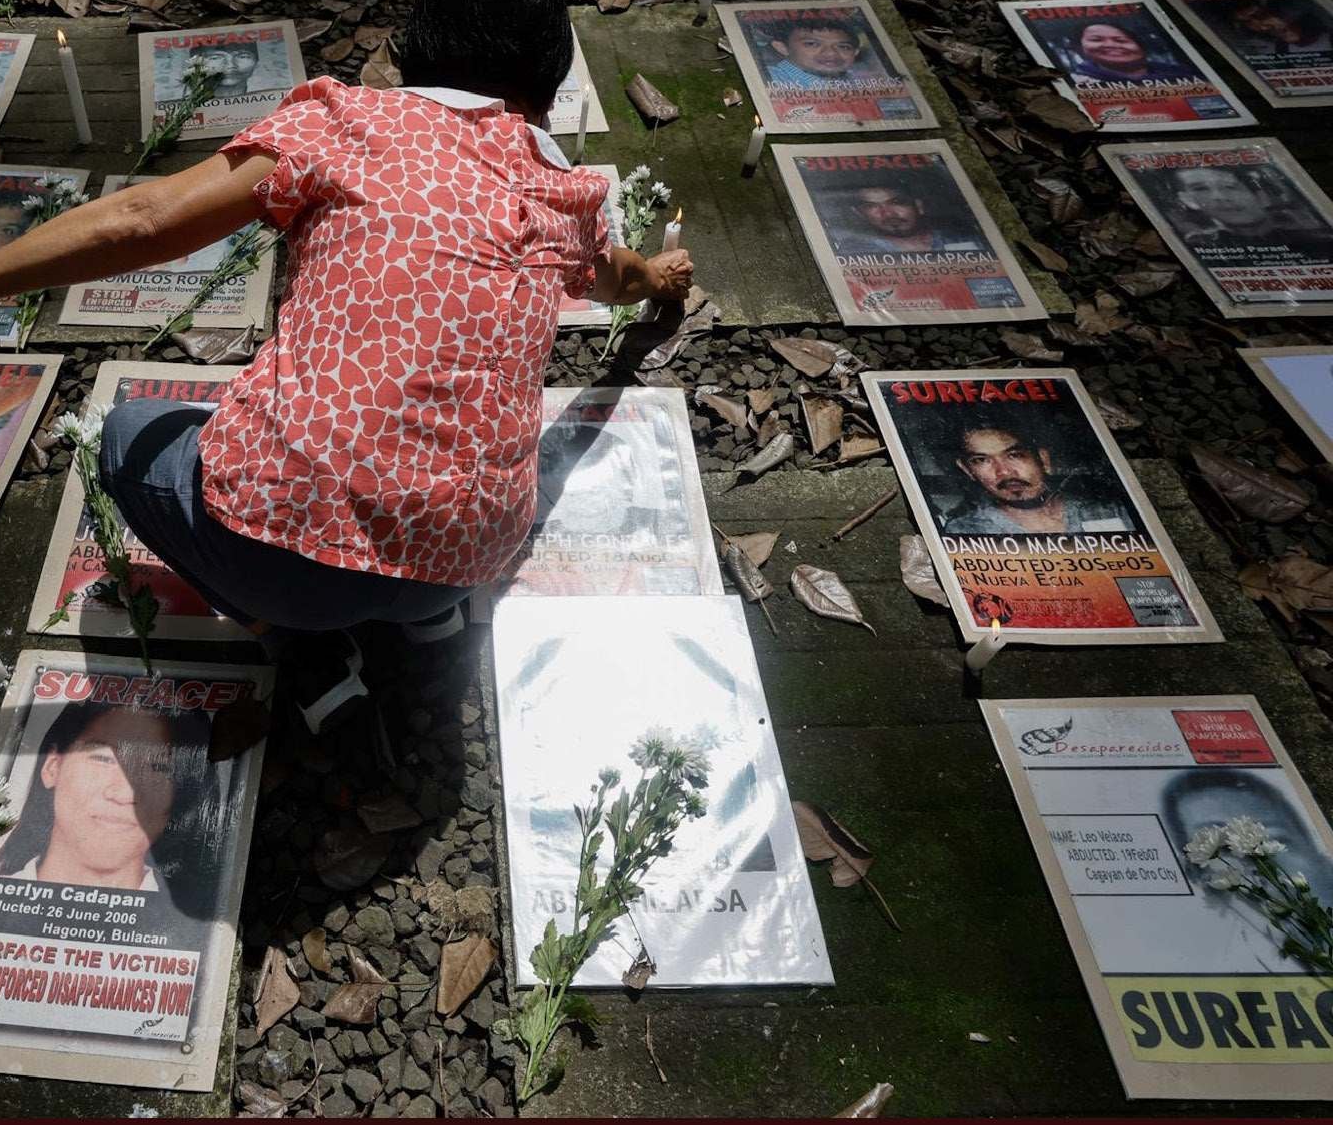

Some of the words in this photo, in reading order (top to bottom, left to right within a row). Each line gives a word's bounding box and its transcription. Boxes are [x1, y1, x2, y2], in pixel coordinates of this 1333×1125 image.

[153, 28, 284, 50] SURFACE!
[766, 80, 804, 92] JONAS
[1075, 81, 1140, 92] CELINA
[1144, 76, 1206, 89] PALMA
[223, 93, 277, 108] BANAAG
[1125, 150, 1270, 172] SURFACE!
[836, 254, 896, 269] DANILO
[900, 251, 998, 267] MACAPAGAL
[1278, 267, 1307, 276] THE
[91, 290, 132, 299] STOP
[133, 285, 172, 293] Abducted:
[85, 298, 133, 306] ENFORCED
[131, 378, 230, 402] SURFA
[893, 377, 1061, 406] SURFACE!
[941, 535, 1021, 556] DANILO
[1026, 534, 1158, 556] MACAPAGAL
[974, 572, 1030, 587] NUEVA
[1037, 572, 1084, 587] ECIJA
[1053, 740, 1182, 757] Desaparecidos
[1050, 830, 1079, 844] NAME:
[1080, 831, 1098, 843] Leo
[1098, 830, 1133, 843] Velasco
[1068, 849, 1118, 862] ABDUCTED:
[1085, 868, 1125, 884] Cagayan
[1126, 868, 1138, 881] de
[1138, 868, 1157, 881] Oro
[1158, 868, 1179, 884] City
[62, 885, 147, 910] Cadapan
[47, 906, 64, 919] 26
[66, 906, 102, 923] June
[103, 910, 138, 926] 2006
[42, 921, 107, 943] Hagonoy,
[111, 928, 169, 947] Bulacan
[64, 948, 104, 969] THE
[109, 952, 197, 977] VICTIMS!
[46, 971, 159, 1014] DISAPPEARANCES
[157, 981, 195, 1017] NOW!
